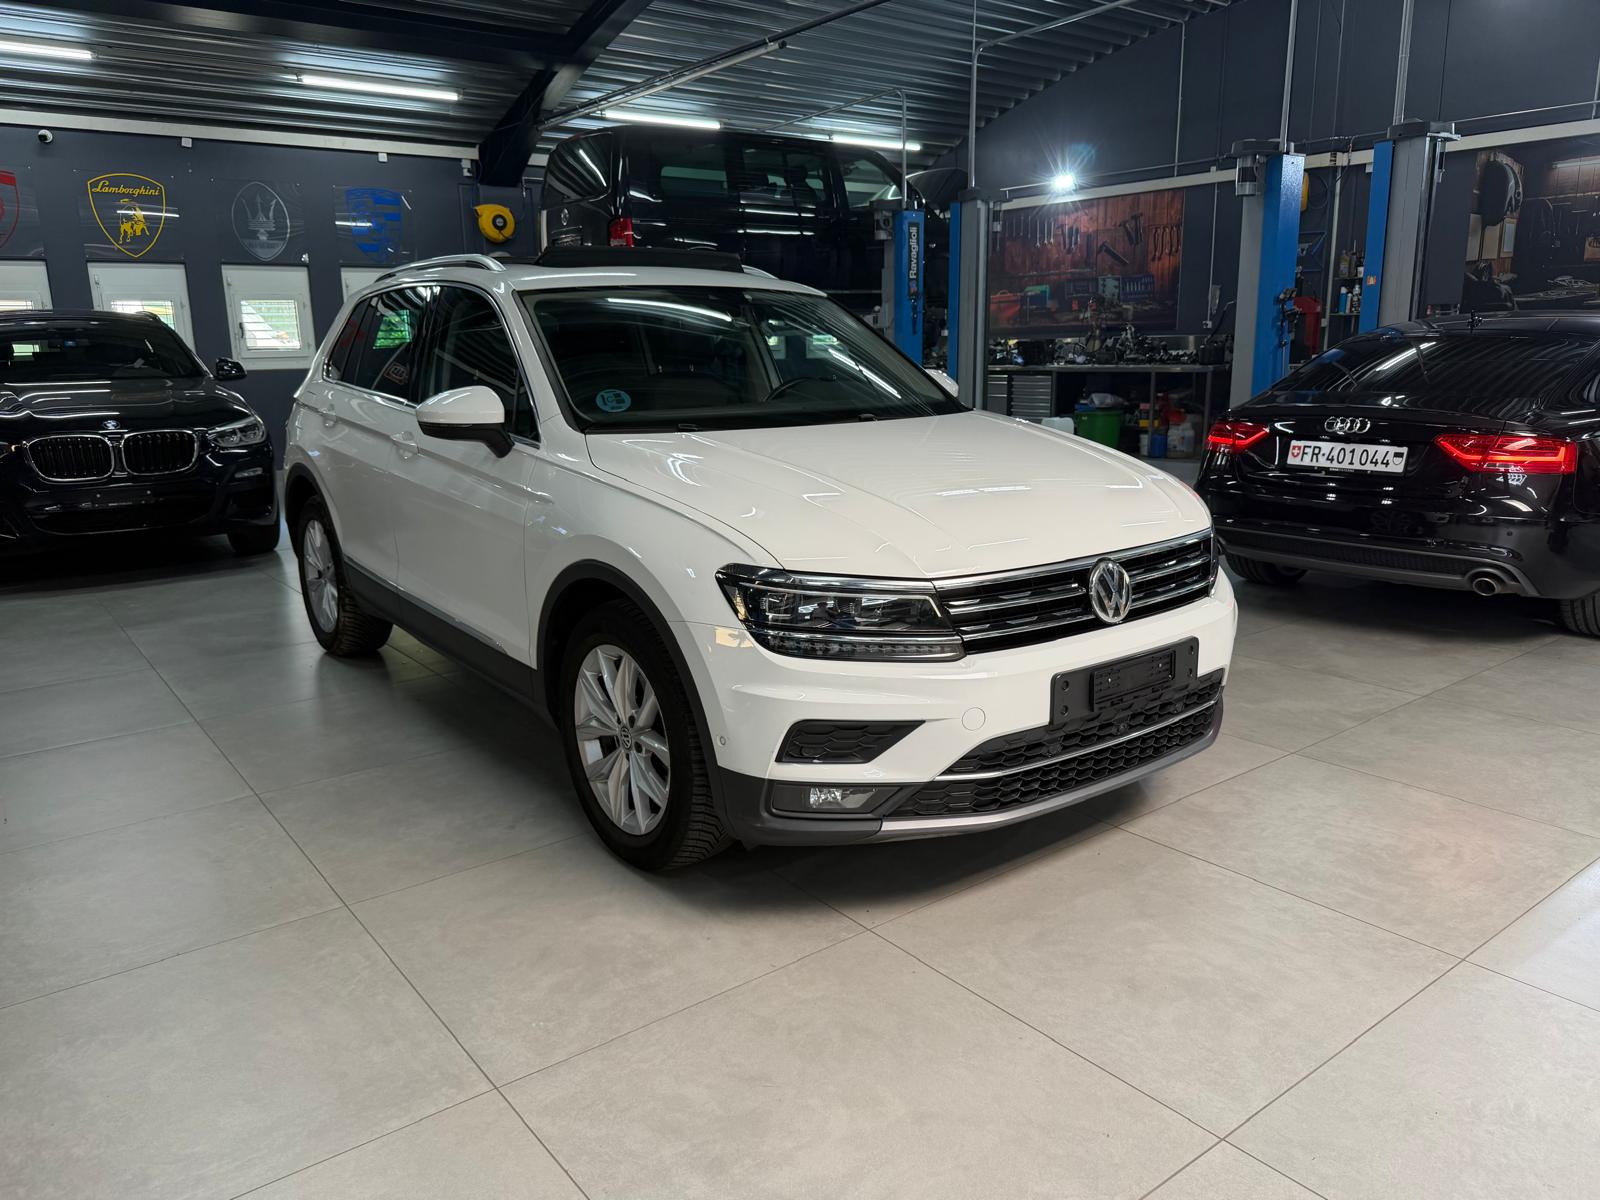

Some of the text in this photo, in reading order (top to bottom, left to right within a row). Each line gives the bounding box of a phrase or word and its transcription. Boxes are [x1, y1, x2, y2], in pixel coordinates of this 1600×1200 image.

[92, 180, 161, 197] Lamborghini
[909, 226, 919, 279] Ravaglioli
[1090, 559, 1131, 622] VW
